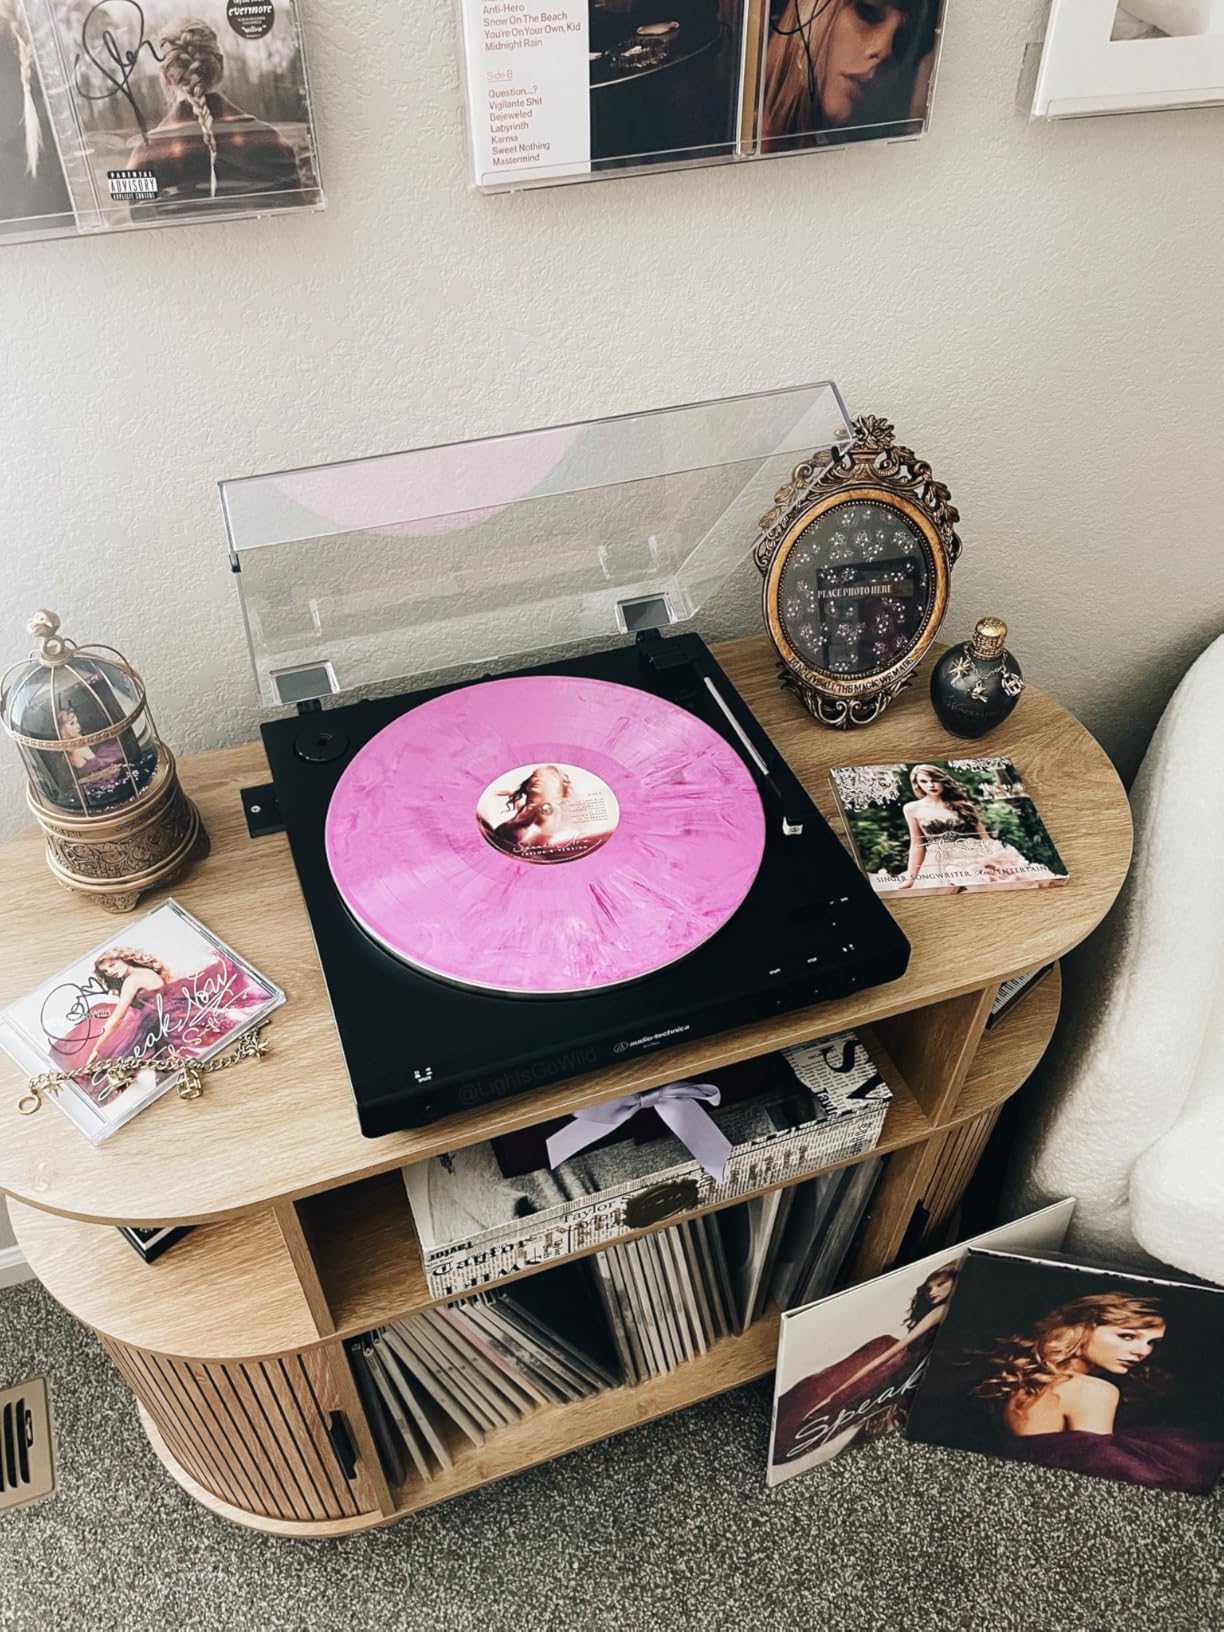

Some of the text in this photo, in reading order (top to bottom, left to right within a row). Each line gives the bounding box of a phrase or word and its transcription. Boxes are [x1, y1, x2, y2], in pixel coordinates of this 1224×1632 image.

[483, 4, 525, 14] Anti-Hero
[483, 11, 568, 27] Snow On The Beach
[484, 22, 581, 39] You're On Your Own, Kid
[485, 38, 543, 52] Midnight Rain
[487, 69, 513, 81] Side B
[488, 85, 538, 99] Question...?
[489, 96, 543, 111] Vigilante Shit
[490, 109, 533, 123] Bejeweled
[490, 121, 529, 134] Labyrinth
[491, 134, 518, 145] Karma
[492, 141, 551, 156] Sweet Nothing
[493, 153, 541, 167] Mastermind
[110, 178, 156, 193] ADVISORY
[817, 584, 892, 599] PLACE PHOTO HERE
[876, 874, 907, 883] SINGER
[910, 870, 971, 881] SONGWRITER
[629, 1025, 690, 1047] audio-technica
[561, 1200, 615, 1224] Taylor
[786, 1355, 930, 1458] Speak
